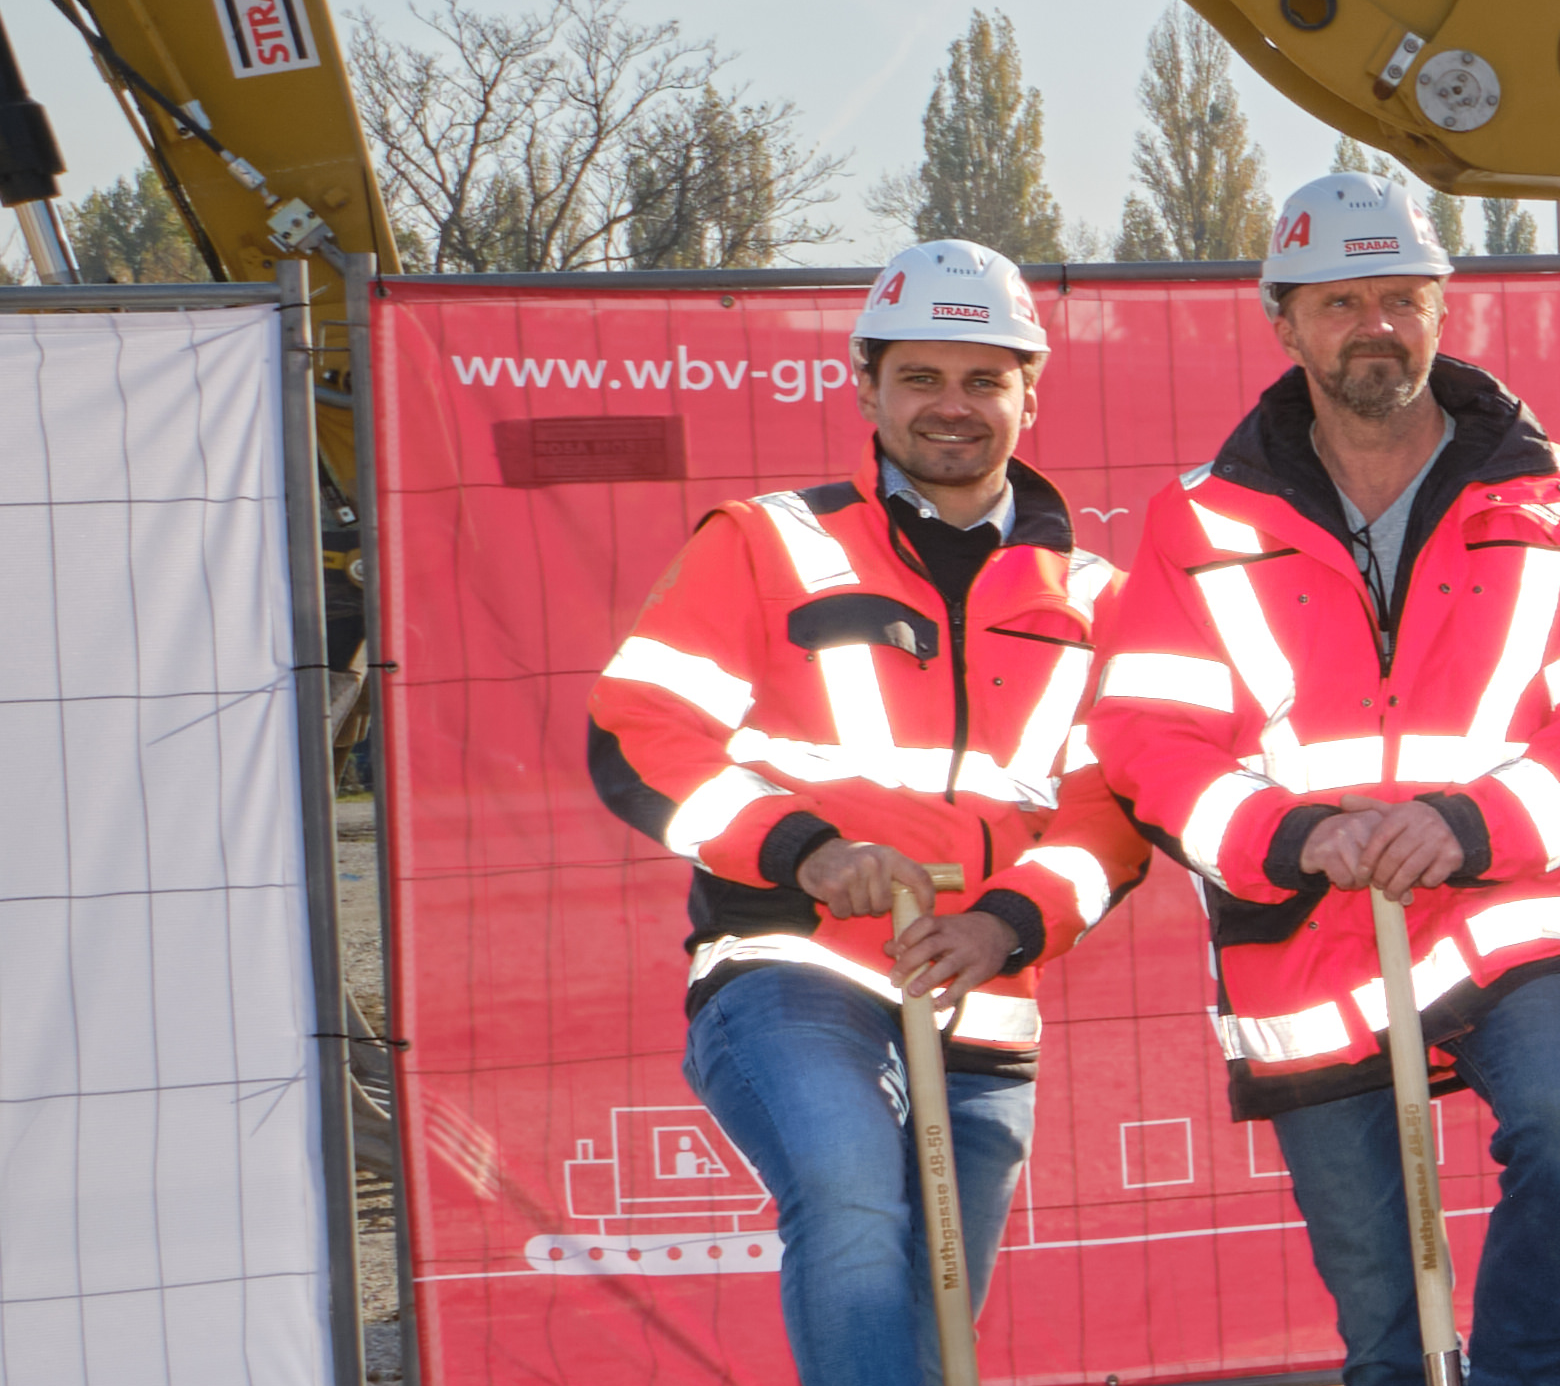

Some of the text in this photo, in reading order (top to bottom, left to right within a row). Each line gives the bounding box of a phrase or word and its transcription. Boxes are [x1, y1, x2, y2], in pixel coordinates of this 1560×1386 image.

[1344, 240, 1400, 253] STRABAG
[932, 306, 990, 319] STRABAG
[451, 345, 860, 403] www.wbv-gp
[925, 1124, 959, 1290] Muthgasse 48-50
